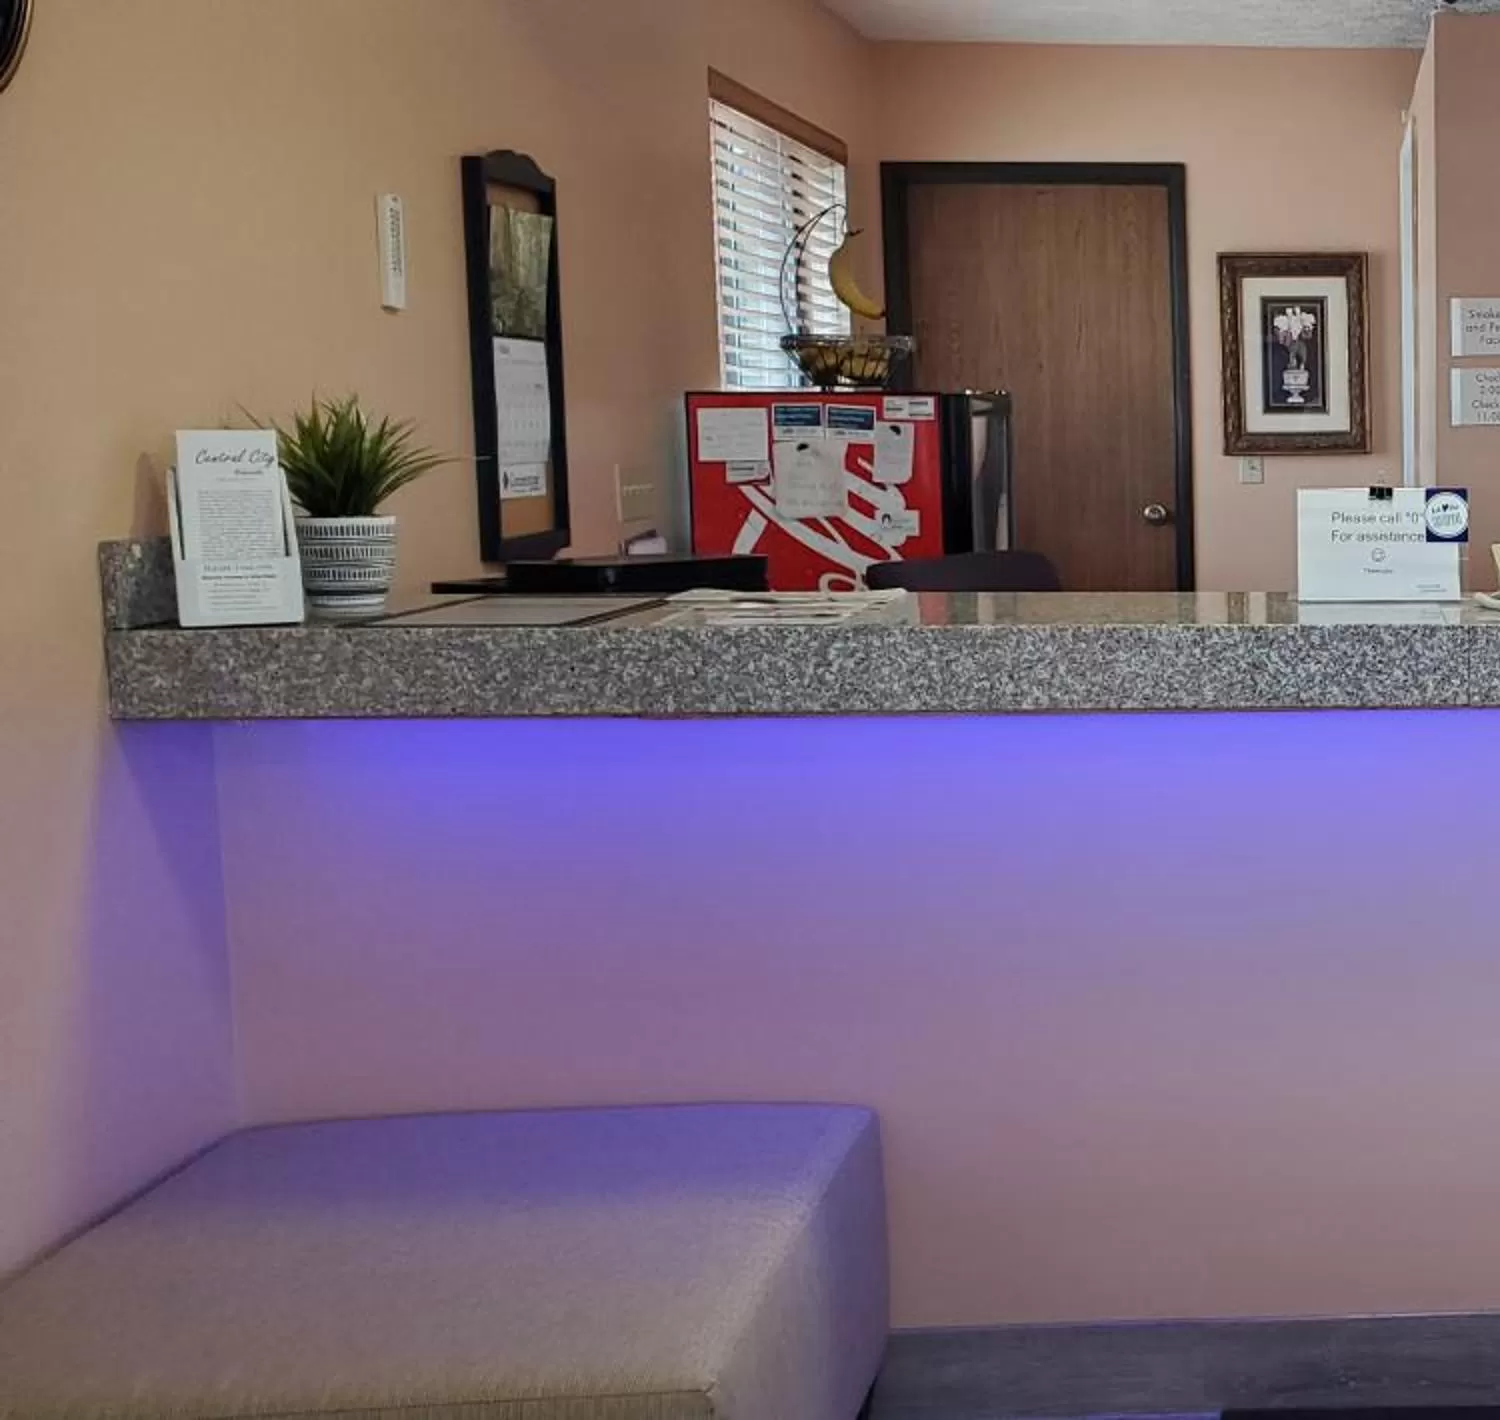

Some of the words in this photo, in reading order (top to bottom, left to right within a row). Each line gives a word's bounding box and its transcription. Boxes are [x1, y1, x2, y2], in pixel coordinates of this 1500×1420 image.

[195, 447, 247, 465] Central
[1330, 511, 1377, 524] Please
[1379, 511, 1402, 524] call
[1330, 529, 1352, 543] For
[1355, 530, 1425, 543] assistance
